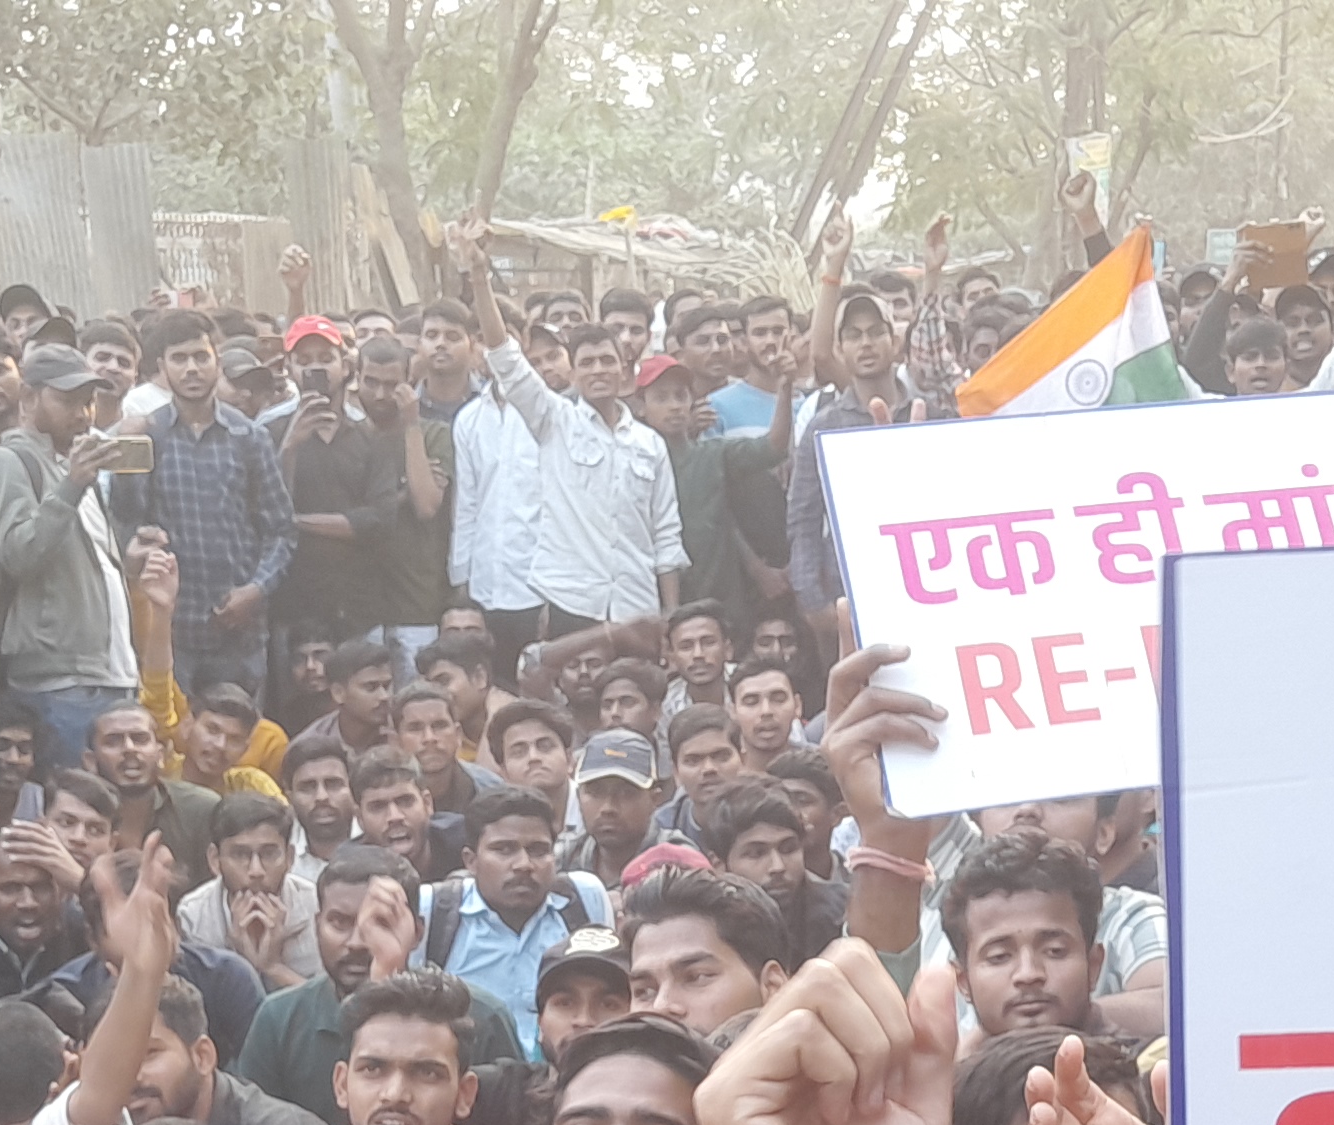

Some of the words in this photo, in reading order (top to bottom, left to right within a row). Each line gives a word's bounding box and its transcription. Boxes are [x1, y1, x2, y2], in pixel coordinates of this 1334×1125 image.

[879, 508, 1056, 605] एक
[1073, 472, 1184, 584] ही
[955, 624, 1161, 736] RE-
